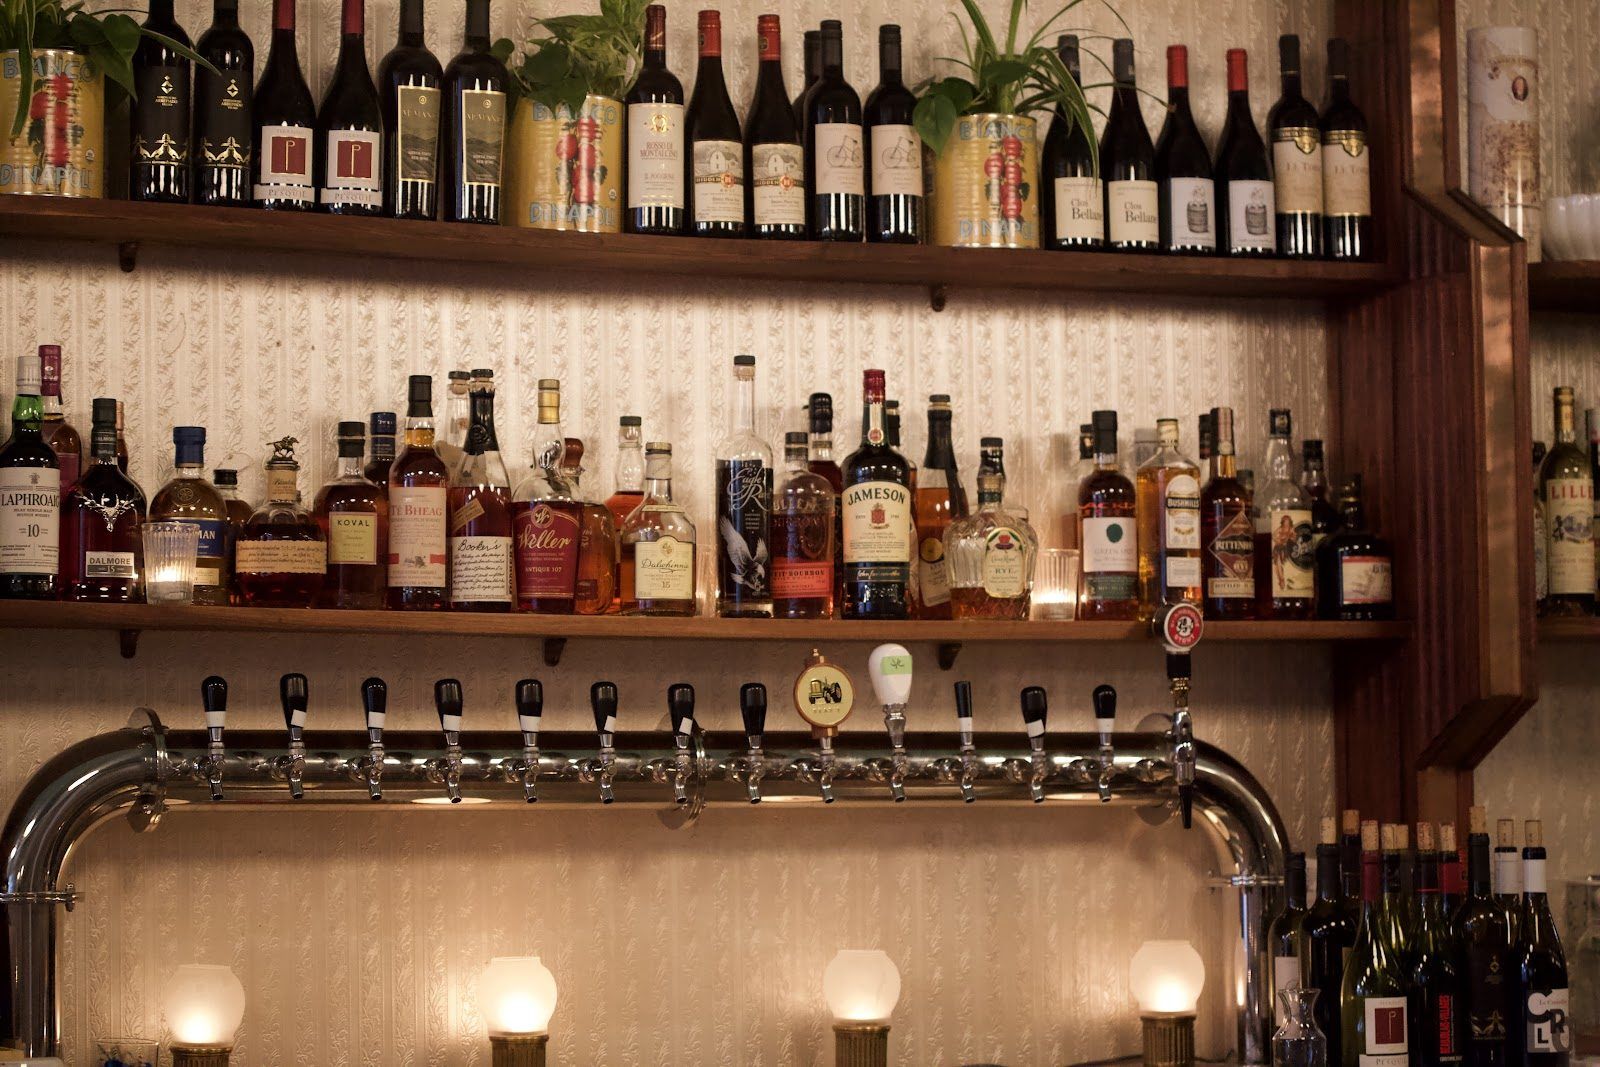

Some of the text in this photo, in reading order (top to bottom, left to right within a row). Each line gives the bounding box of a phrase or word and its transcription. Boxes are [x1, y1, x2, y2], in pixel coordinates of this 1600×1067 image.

[3, 56, 96, 84] BANCO
[848, 487, 906, 506] JAMESON
[1167, 498, 1200, 508] BUSHMILLS
[27, 523, 40, 538] 10
[337, 519, 370, 527] KOVAL
[518, 524, 571, 549] Weller
[89, 557, 131, 565] DALMORE
